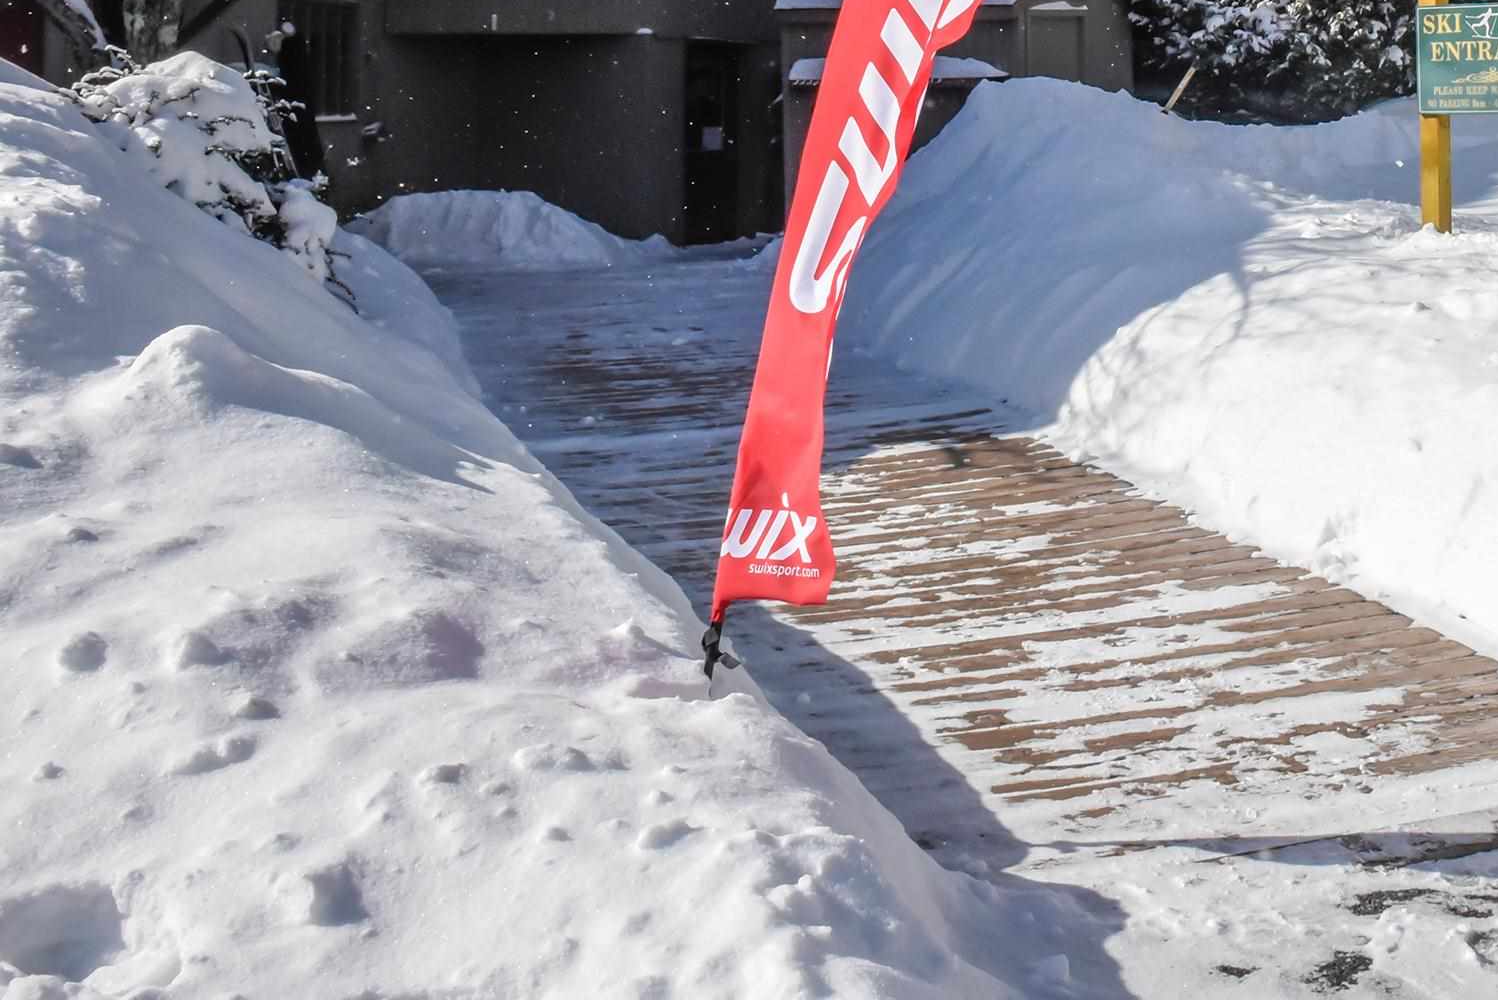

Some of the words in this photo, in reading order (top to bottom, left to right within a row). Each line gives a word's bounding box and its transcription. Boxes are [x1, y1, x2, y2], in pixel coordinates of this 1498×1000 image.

[1423, 12, 1463, 35] SKI
[1433, 86, 1463, 96] PLEASE
[1466, 86, 1489, 95] KEEP
[748, 562, 820, 577] swixsport.com
